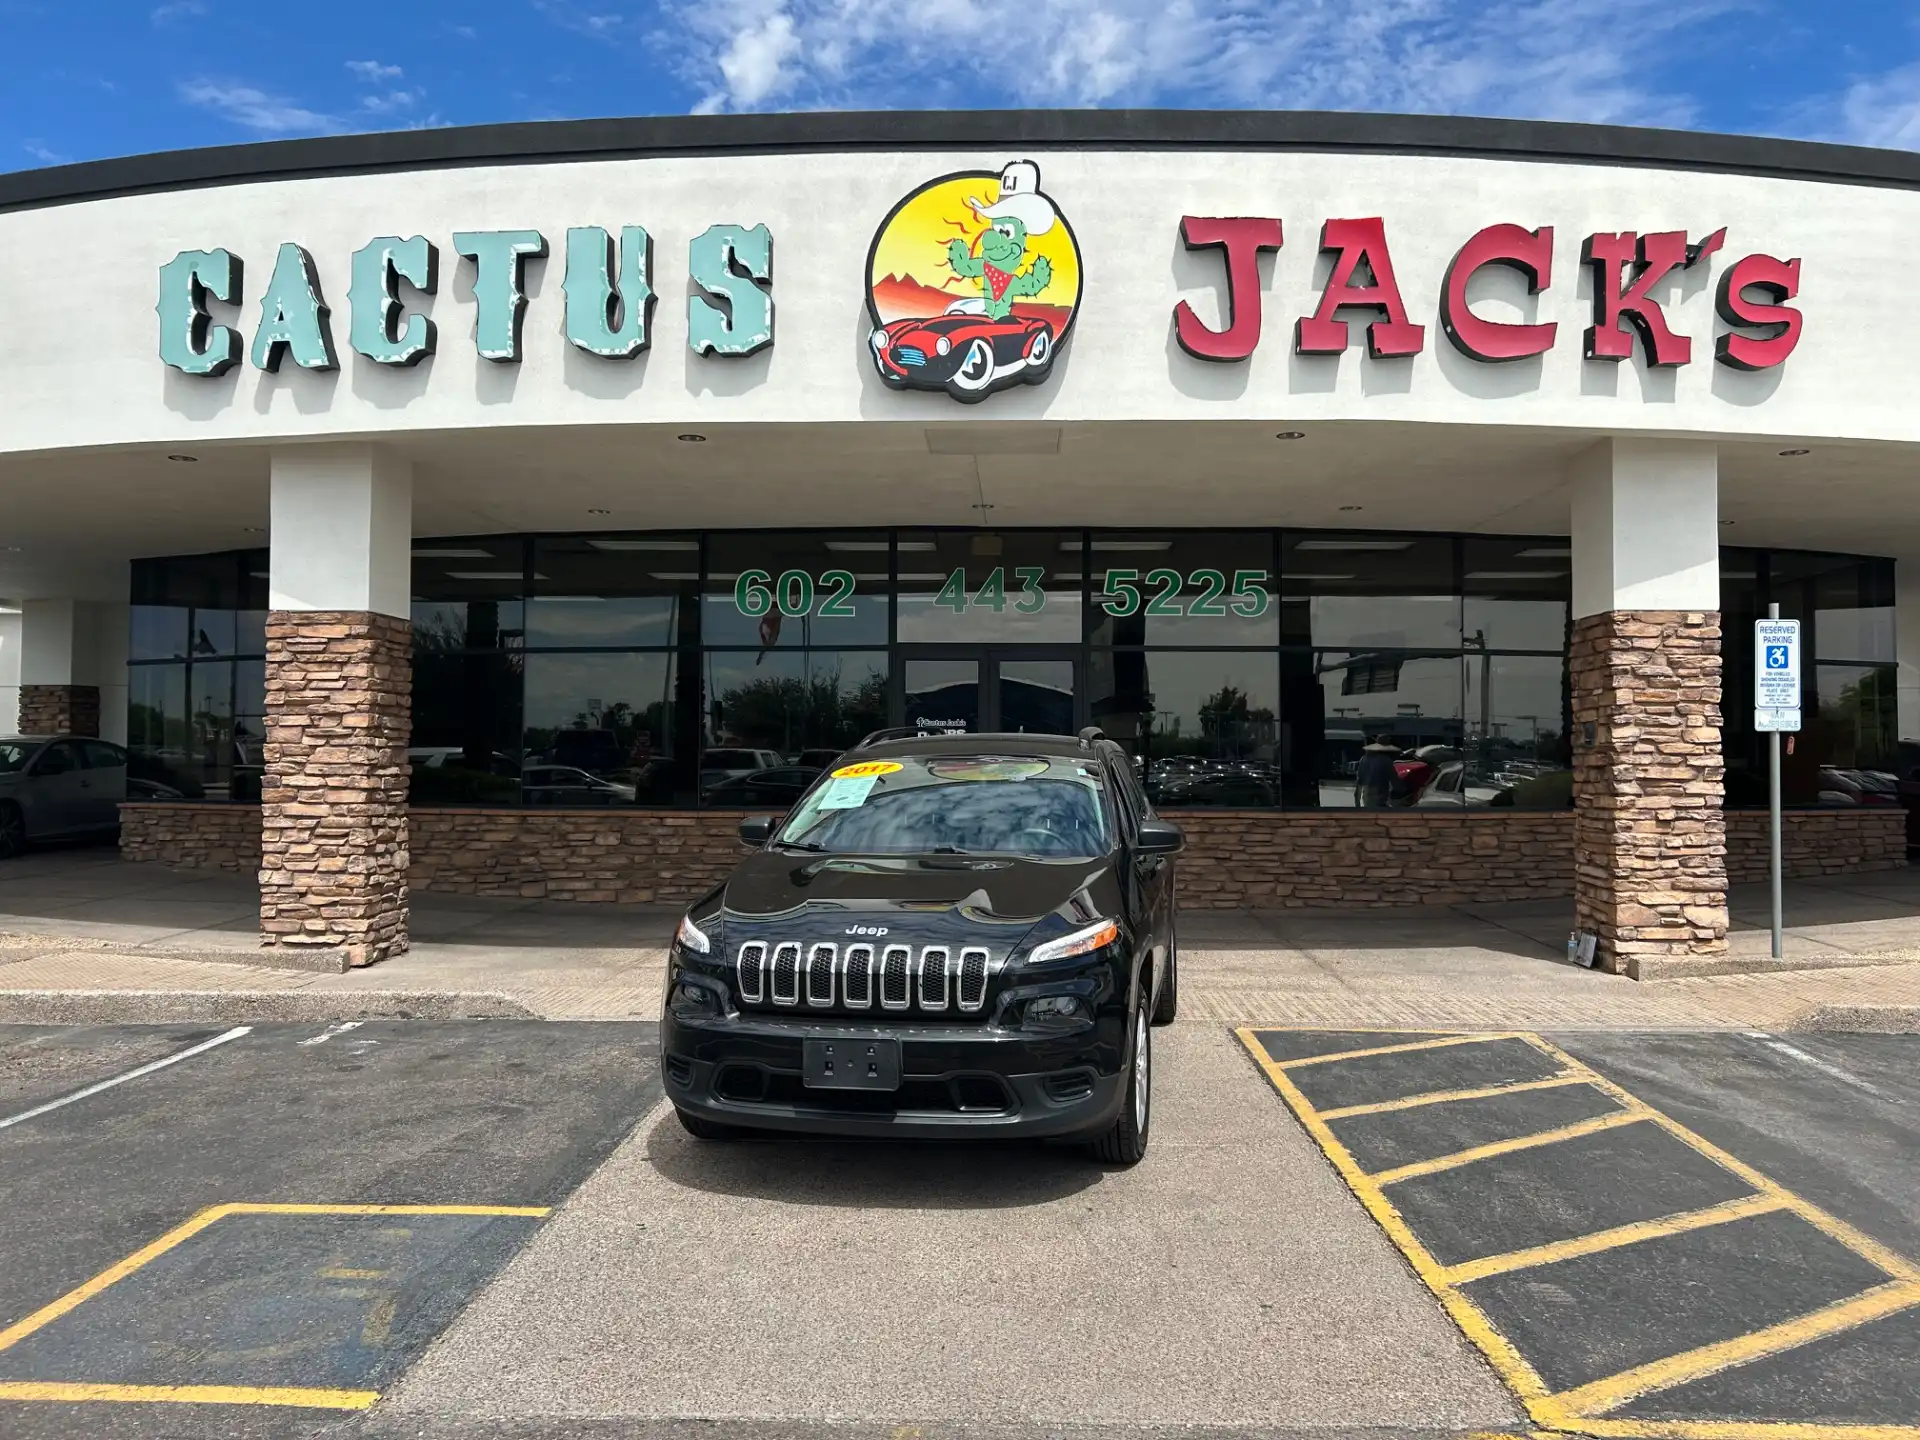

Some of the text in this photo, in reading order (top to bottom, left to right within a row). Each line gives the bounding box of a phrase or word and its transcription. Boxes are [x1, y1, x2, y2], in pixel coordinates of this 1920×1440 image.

[1002, 175, 1018, 191] CJ
[158, 222, 774, 377] CACTUS
[734, 566, 1270, 618] 602 443 5225
[1760, 625, 1796, 634] RESERVED
[1763, 635, 1793, 644] PARKING
[839, 763, 896, 777] 2017
[845, 924, 889, 937] Jeep
